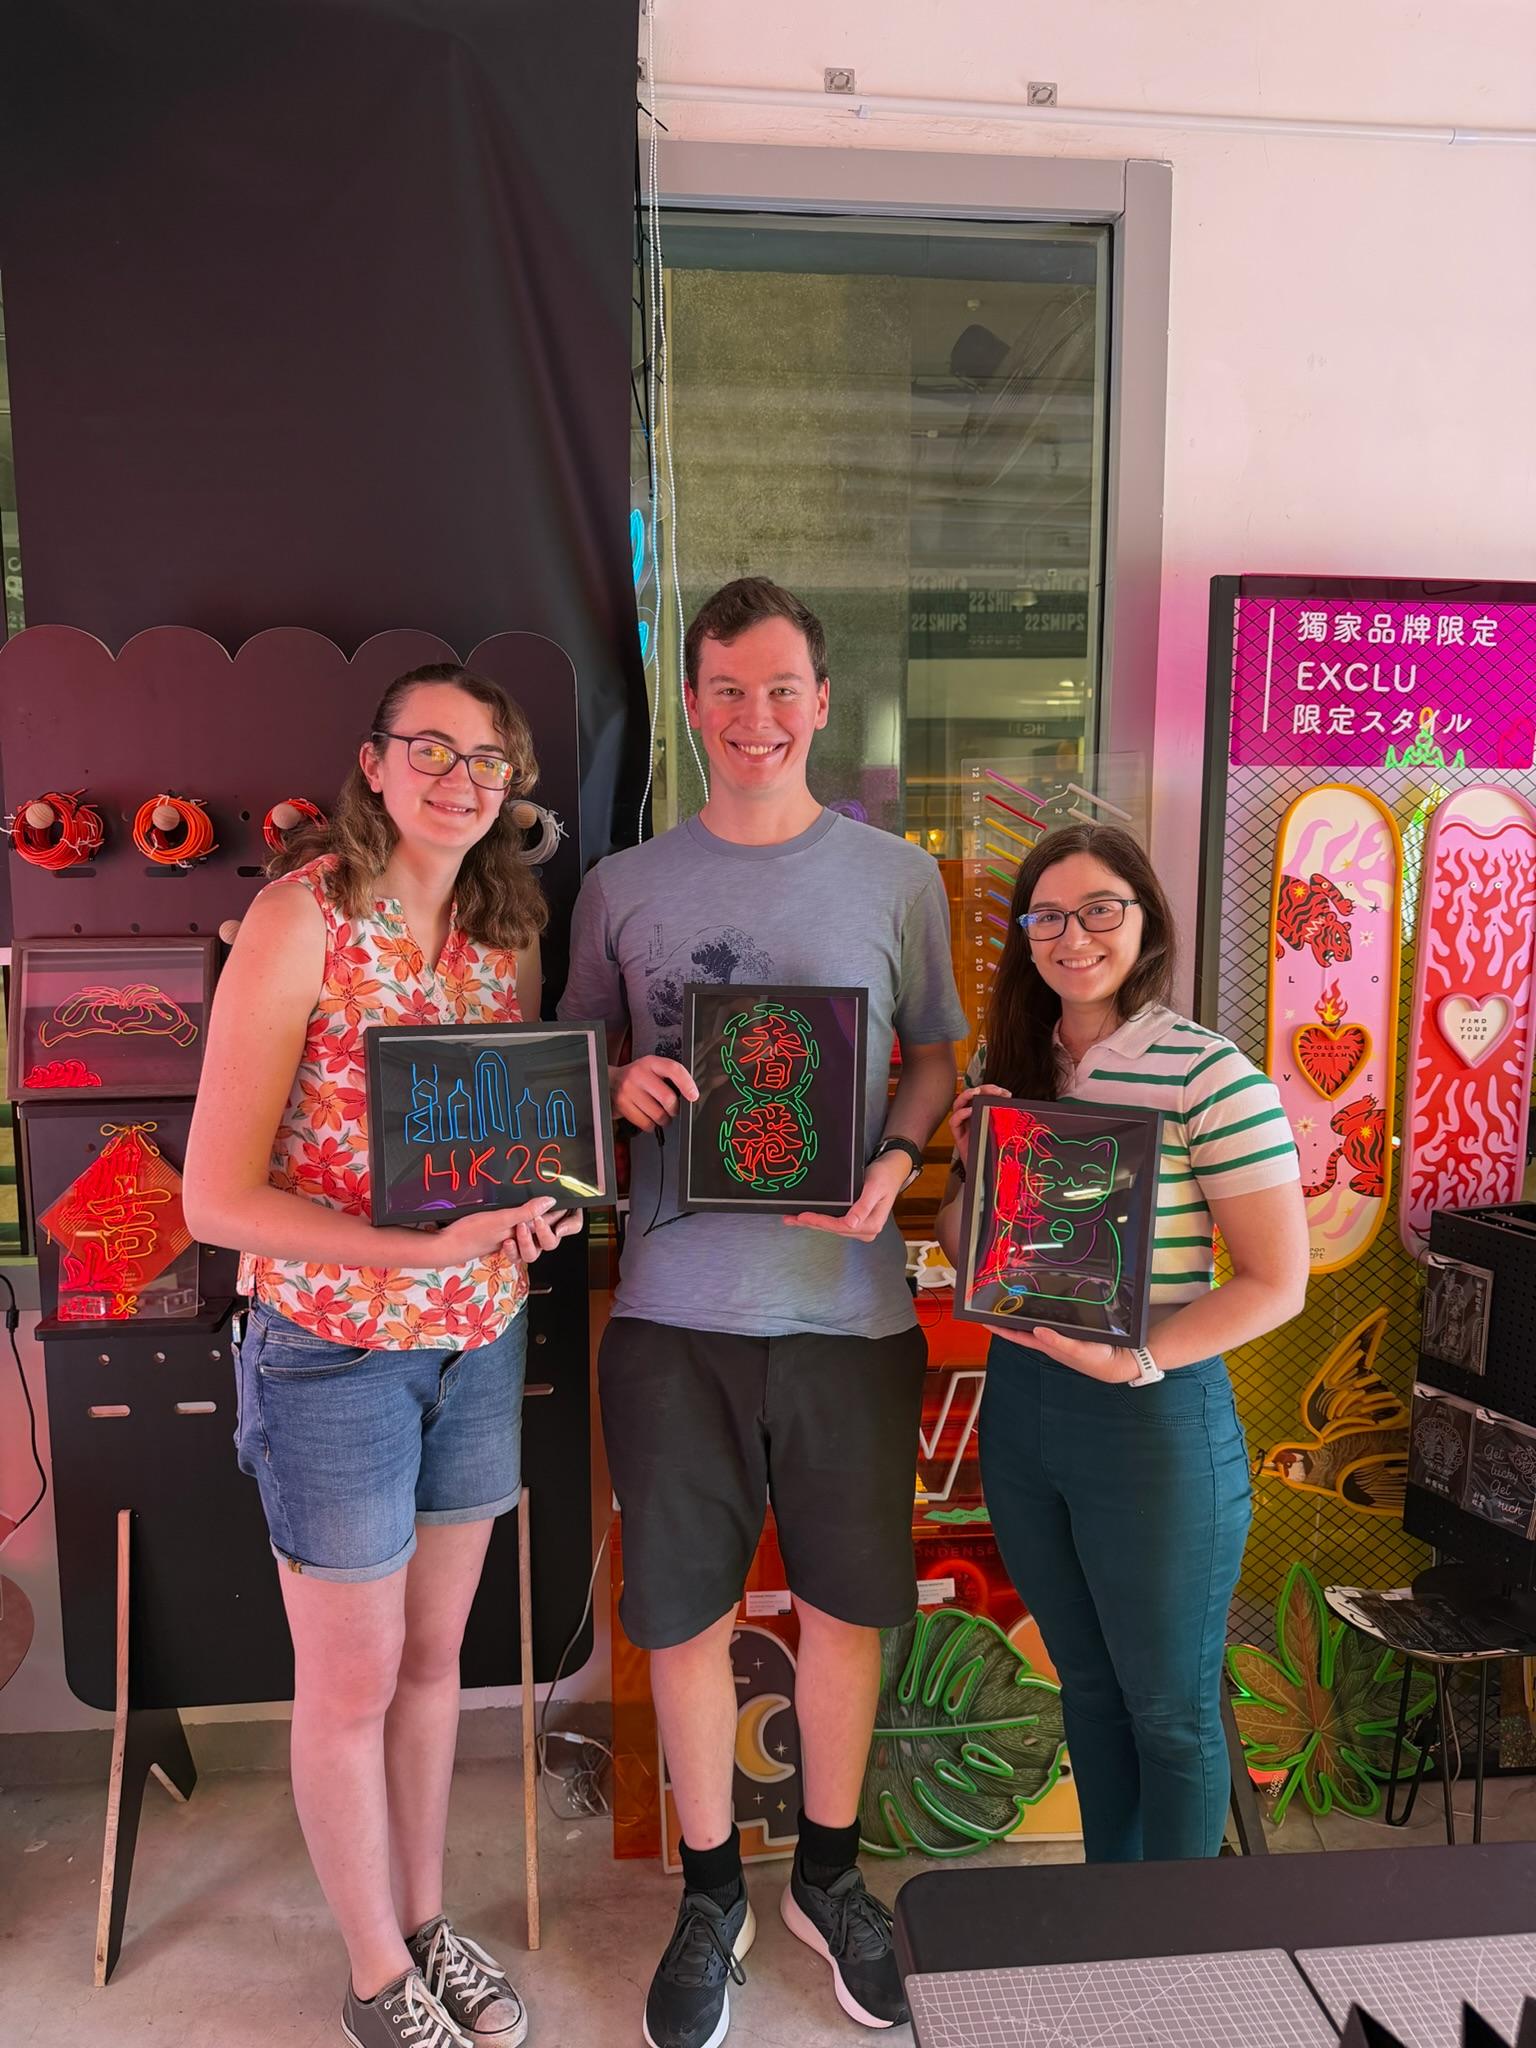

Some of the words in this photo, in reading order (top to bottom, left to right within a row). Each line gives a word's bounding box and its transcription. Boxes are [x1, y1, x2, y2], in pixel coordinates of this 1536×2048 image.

[1298, 611, 1498, 647] 獨家品牌限定
[1297, 661, 1417, 693] EXCLU
[1293, 704, 1472, 735] 限定スタイル
[972, 767, 979, 778] 12
[973, 791, 980, 802] 13
[974, 863, 981, 875] 16
[975, 887, 982, 898] 17
[975, 911, 982, 922] 18
[975, 935, 982, 947] 19
[976, 958, 983, 972] 20
[976, 983, 984, 994] 21
[424, 1143, 562, 1192] HK26
